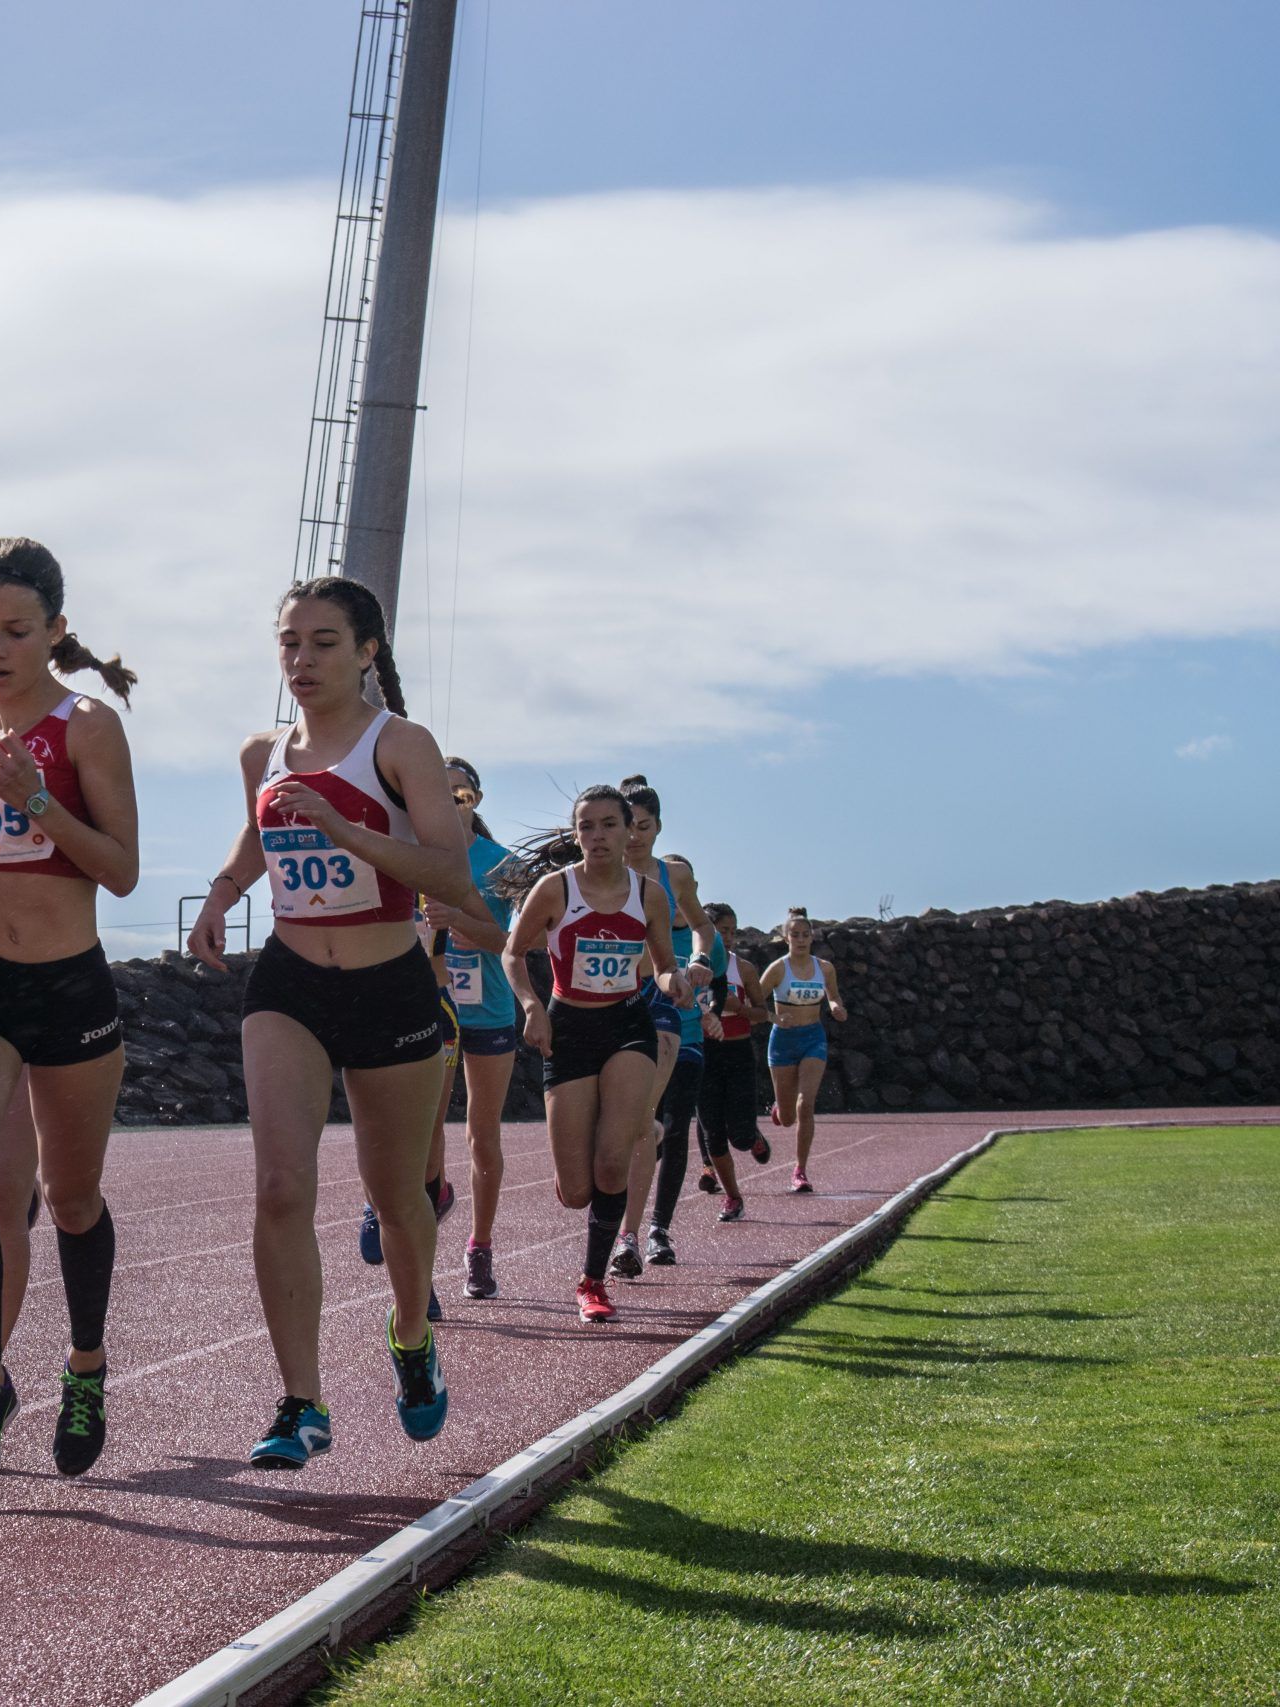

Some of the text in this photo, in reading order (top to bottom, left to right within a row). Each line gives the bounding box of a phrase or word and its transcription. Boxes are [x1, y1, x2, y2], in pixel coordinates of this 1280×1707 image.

[279, 855, 355, 891] 303
[584, 957, 631, 977] 302
[449, 971, 471, 990] 2
[795, 989, 819, 999] 183
